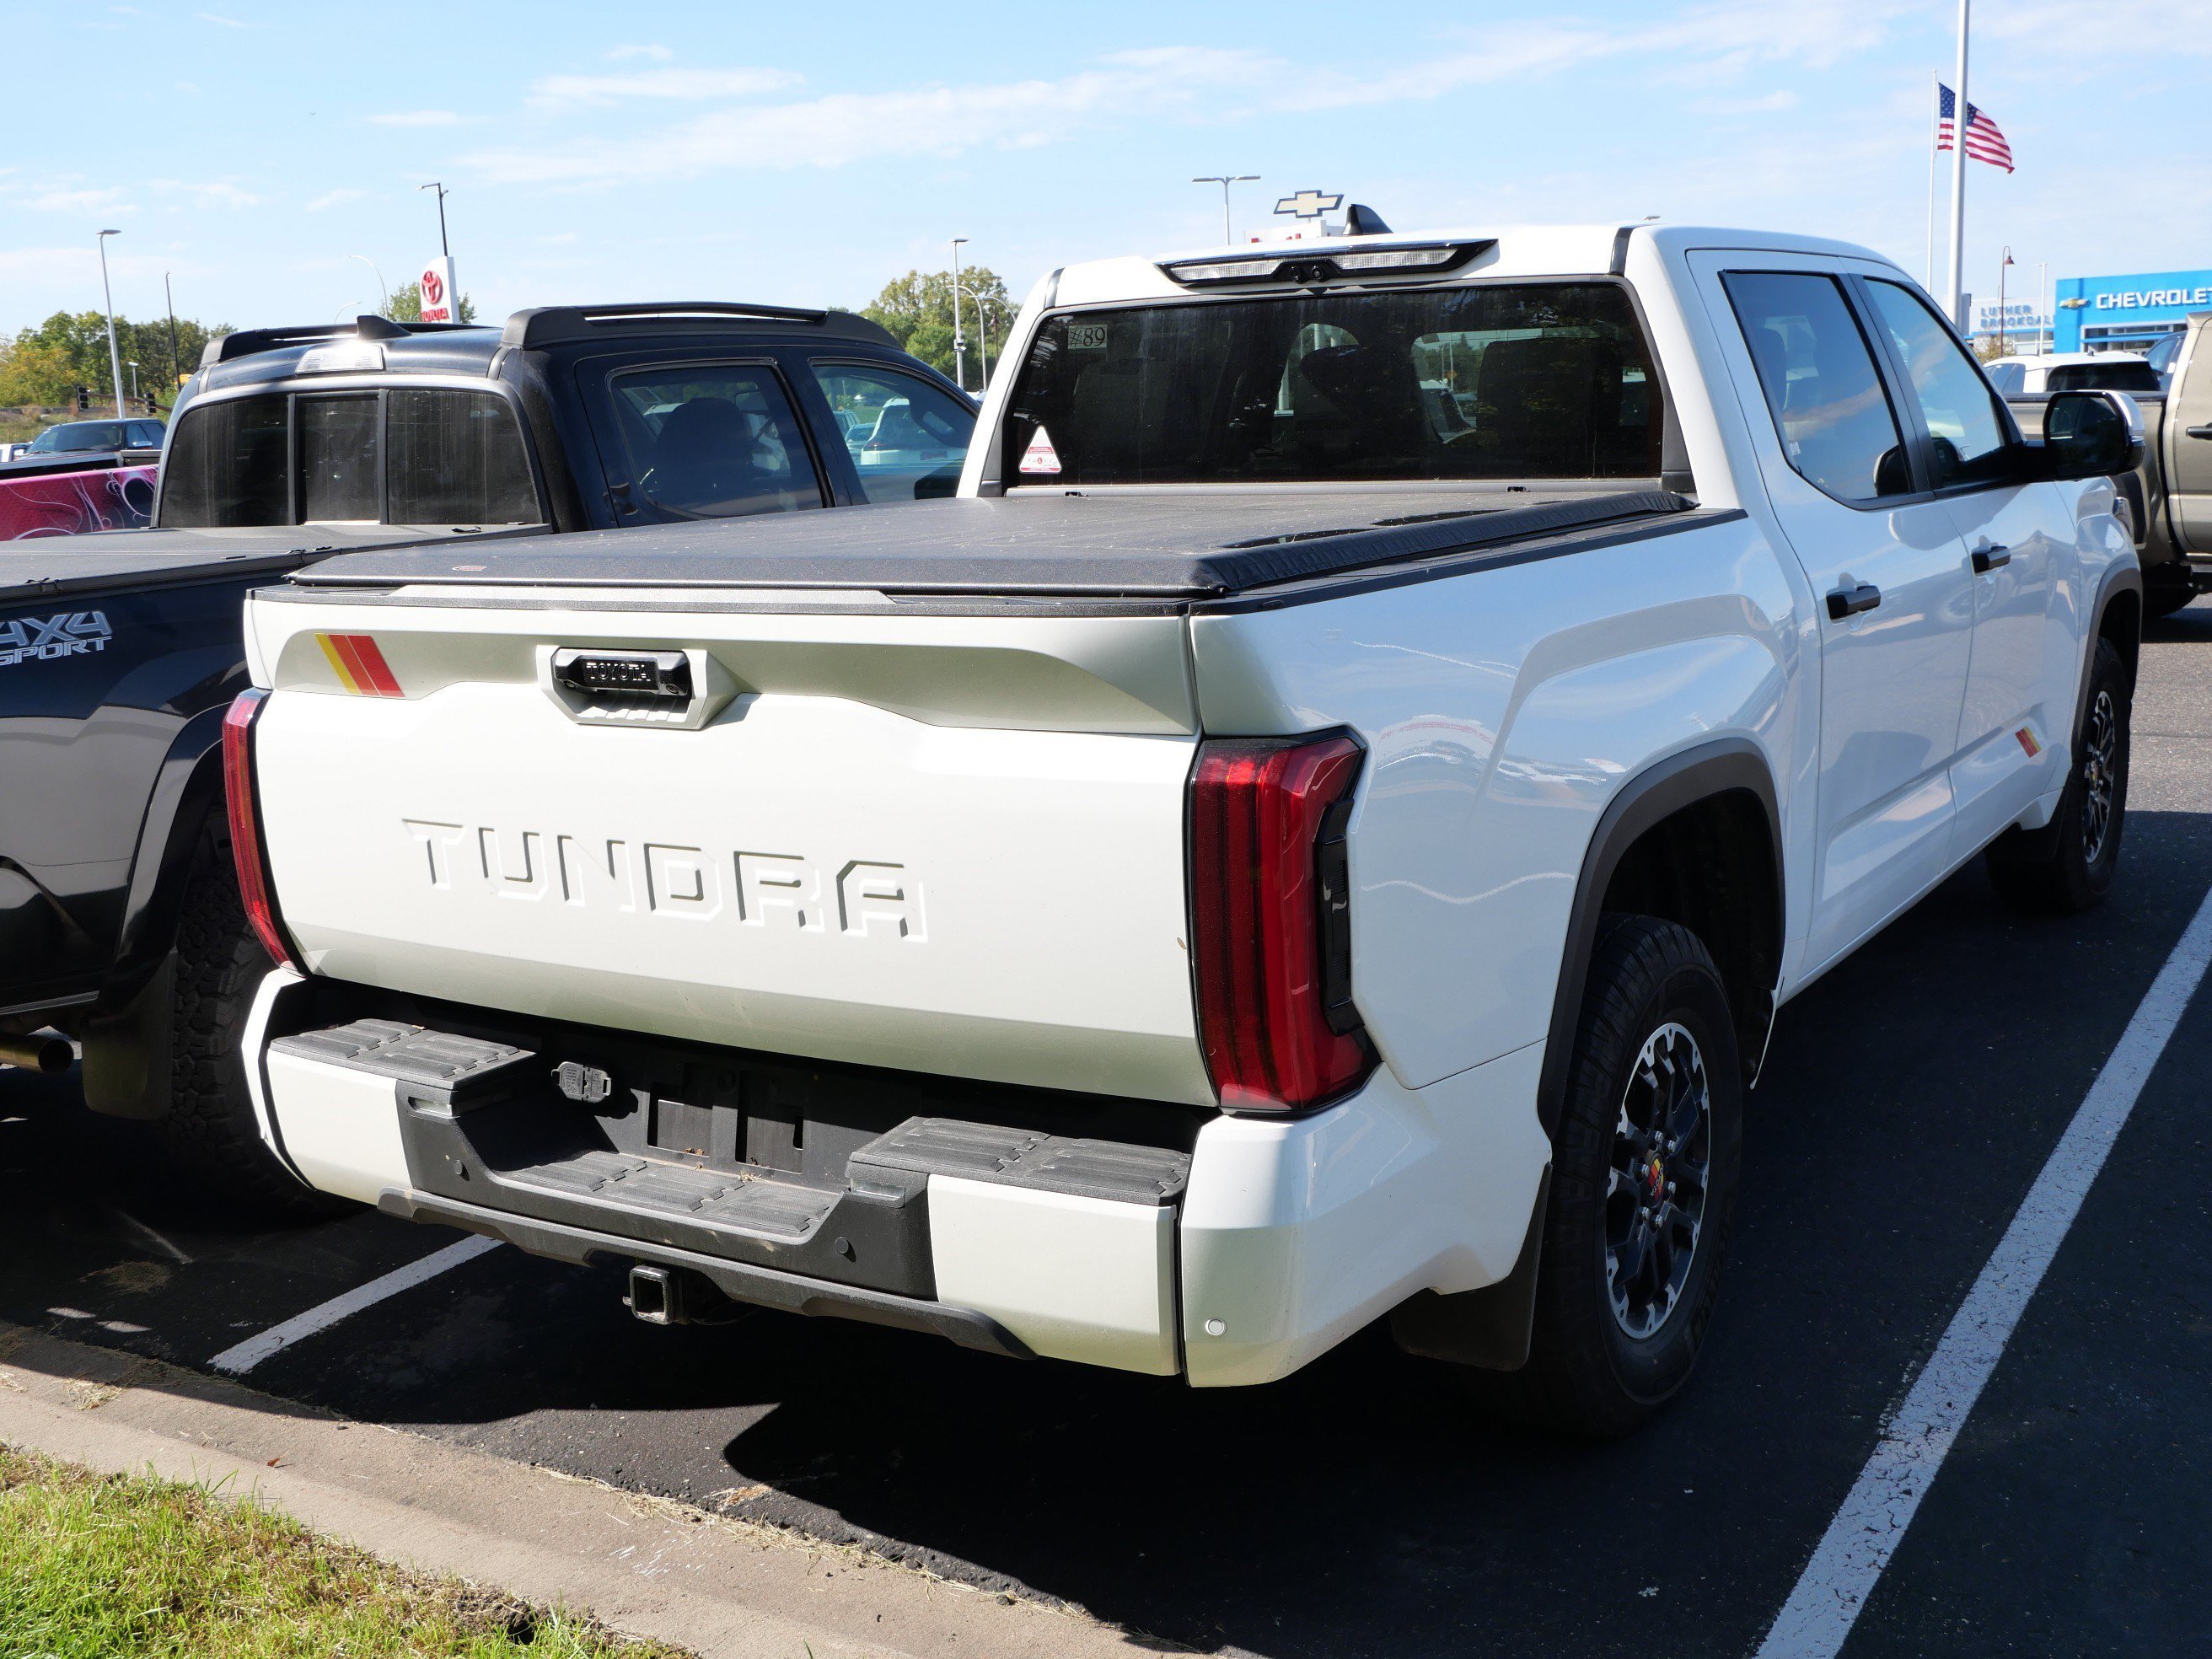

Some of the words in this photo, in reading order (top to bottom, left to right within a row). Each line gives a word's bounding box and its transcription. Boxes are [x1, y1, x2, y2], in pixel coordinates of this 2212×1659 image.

[421, 308, 450, 322] TOYOTA
[1980, 304, 2032, 317] LUTHER
[1980, 315, 2055, 328] BROOKDAL
[1069, 325, 1105, 347] #89
[0, 636, 112, 666] SPORT
[586, 662, 651, 681] TOYOTA
[401, 819, 927, 942] TUNDRA
